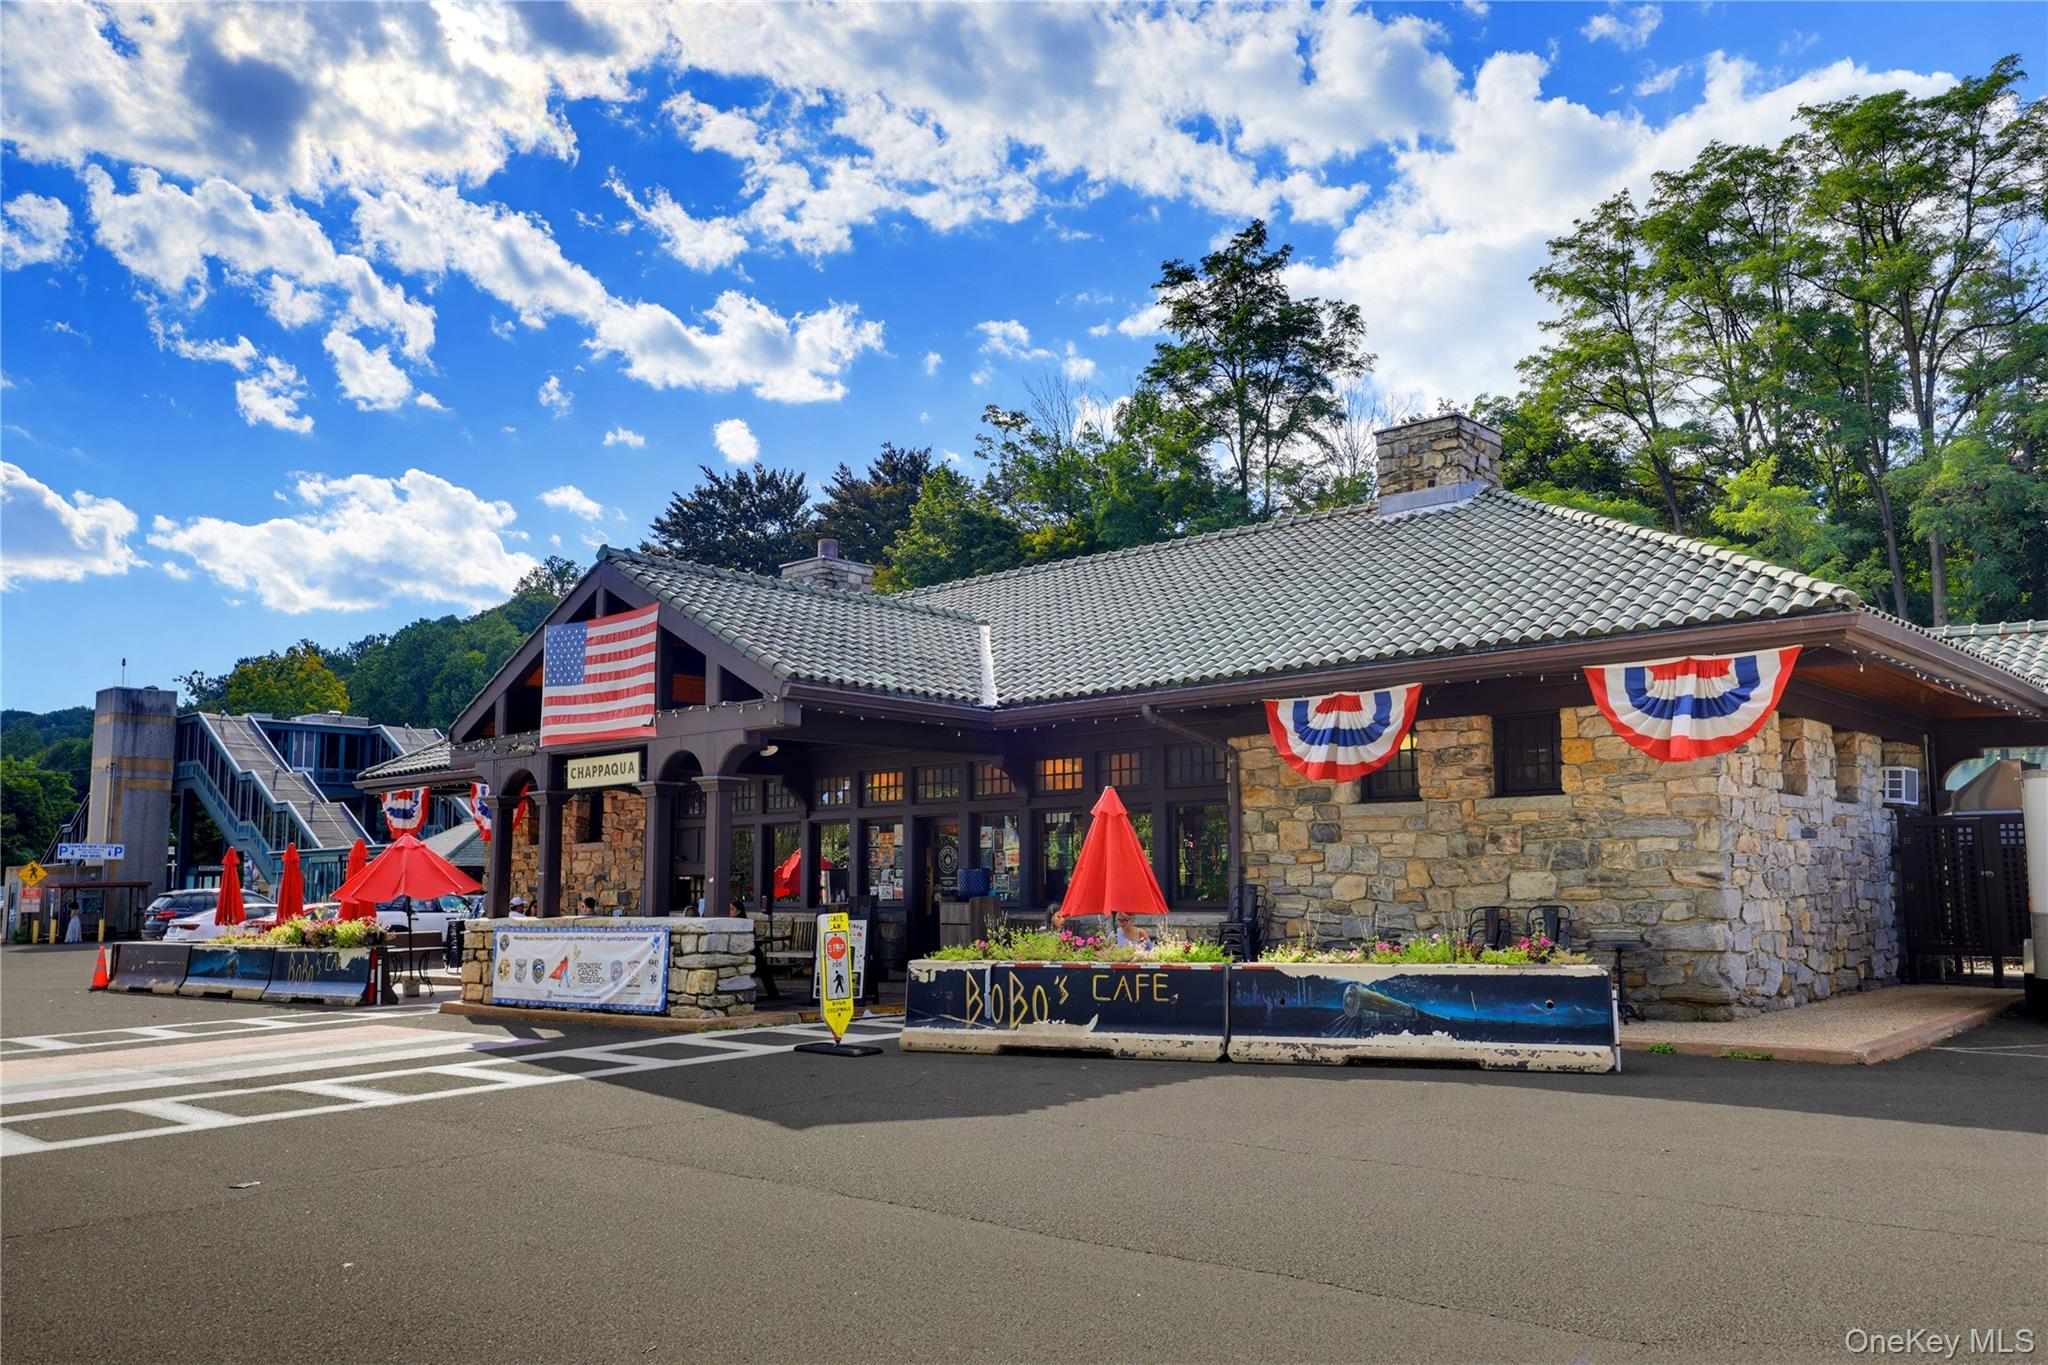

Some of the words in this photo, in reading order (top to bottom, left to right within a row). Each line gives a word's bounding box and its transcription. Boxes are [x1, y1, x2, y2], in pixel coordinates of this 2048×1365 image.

[570, 761, 635, 780] CHAPPAQUA
[59, 846, 68, 857] P
[114, 847, 123, 857] P
[1092, 973, 1170, 1002] CAFE
